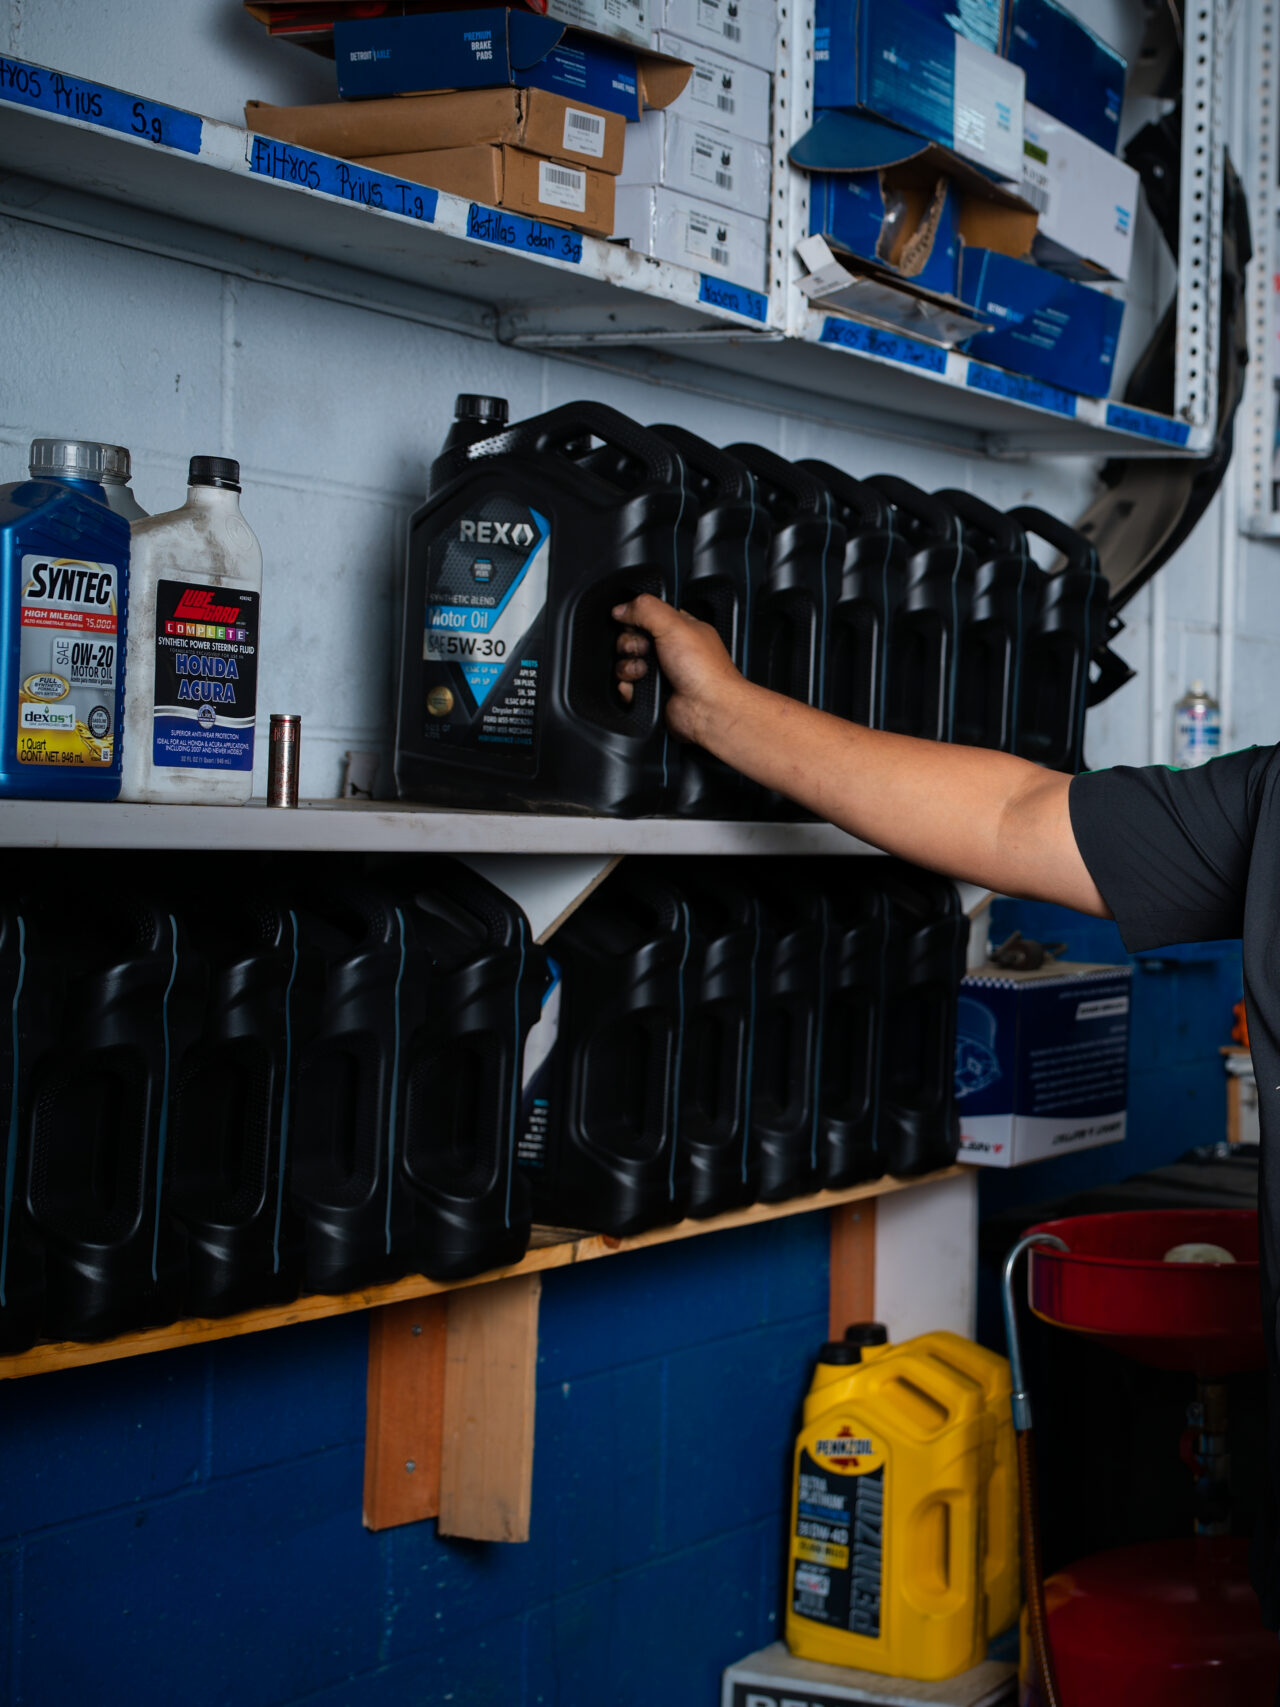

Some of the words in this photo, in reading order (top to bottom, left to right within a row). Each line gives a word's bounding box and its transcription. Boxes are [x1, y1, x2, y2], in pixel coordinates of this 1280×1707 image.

[464, 31, 491, 41] PREMIUM
[471, 41, 491, 51] BRAKE
[351, 51, 372, 61] DETROIT
[476, 51, 493, 61] PADS
[50, 73, 103, 117] Prius
[254, 138, 321, 190] Filtros
[336, 164, 383, 207] Prius
[469, 203, 516, 243] Pastillas
[28, 563, 112, 605] SYNTEC
[471, 595, 496, 606] BLEND
[25, 610, 47, 618] HIGH
[50, 612, 83, 622] MILEAGE
[429, 608, 468, 627] Motor
[471, 611, 488, 629] Oil
[167, 623, 244, 640] COMPLETE
[57, 641, 70, 665] SAE
[158, 637, 189, 648] SYNTHETIC
[190, 639, 211, 650] POWER
[212, 643, 238, 653] STEERING
[240, 645, 255, 655] FLUID
[428, 635, 446, 653] SAE
[447, 637, 506, 657] 5W-30
[72, 643, 114, 668] 0W-20
[72, 666, 99, 678] MOTOR
[101, 667, 113, 679] OIL
[176, 653, 240, 680] HONDA
[178, 679, 237, 704] ACURA
[22, 739, 25, 749] 1
[27, 739, 46, 750] Quart
[21, 750, 44, 762] CONT.
[45, 751, 60, 762] NET.
[62, 752, 74, 764] 946
[75, 753, 84, 764] mL
[816, 1438, 875, 1457] PENNZOIL
